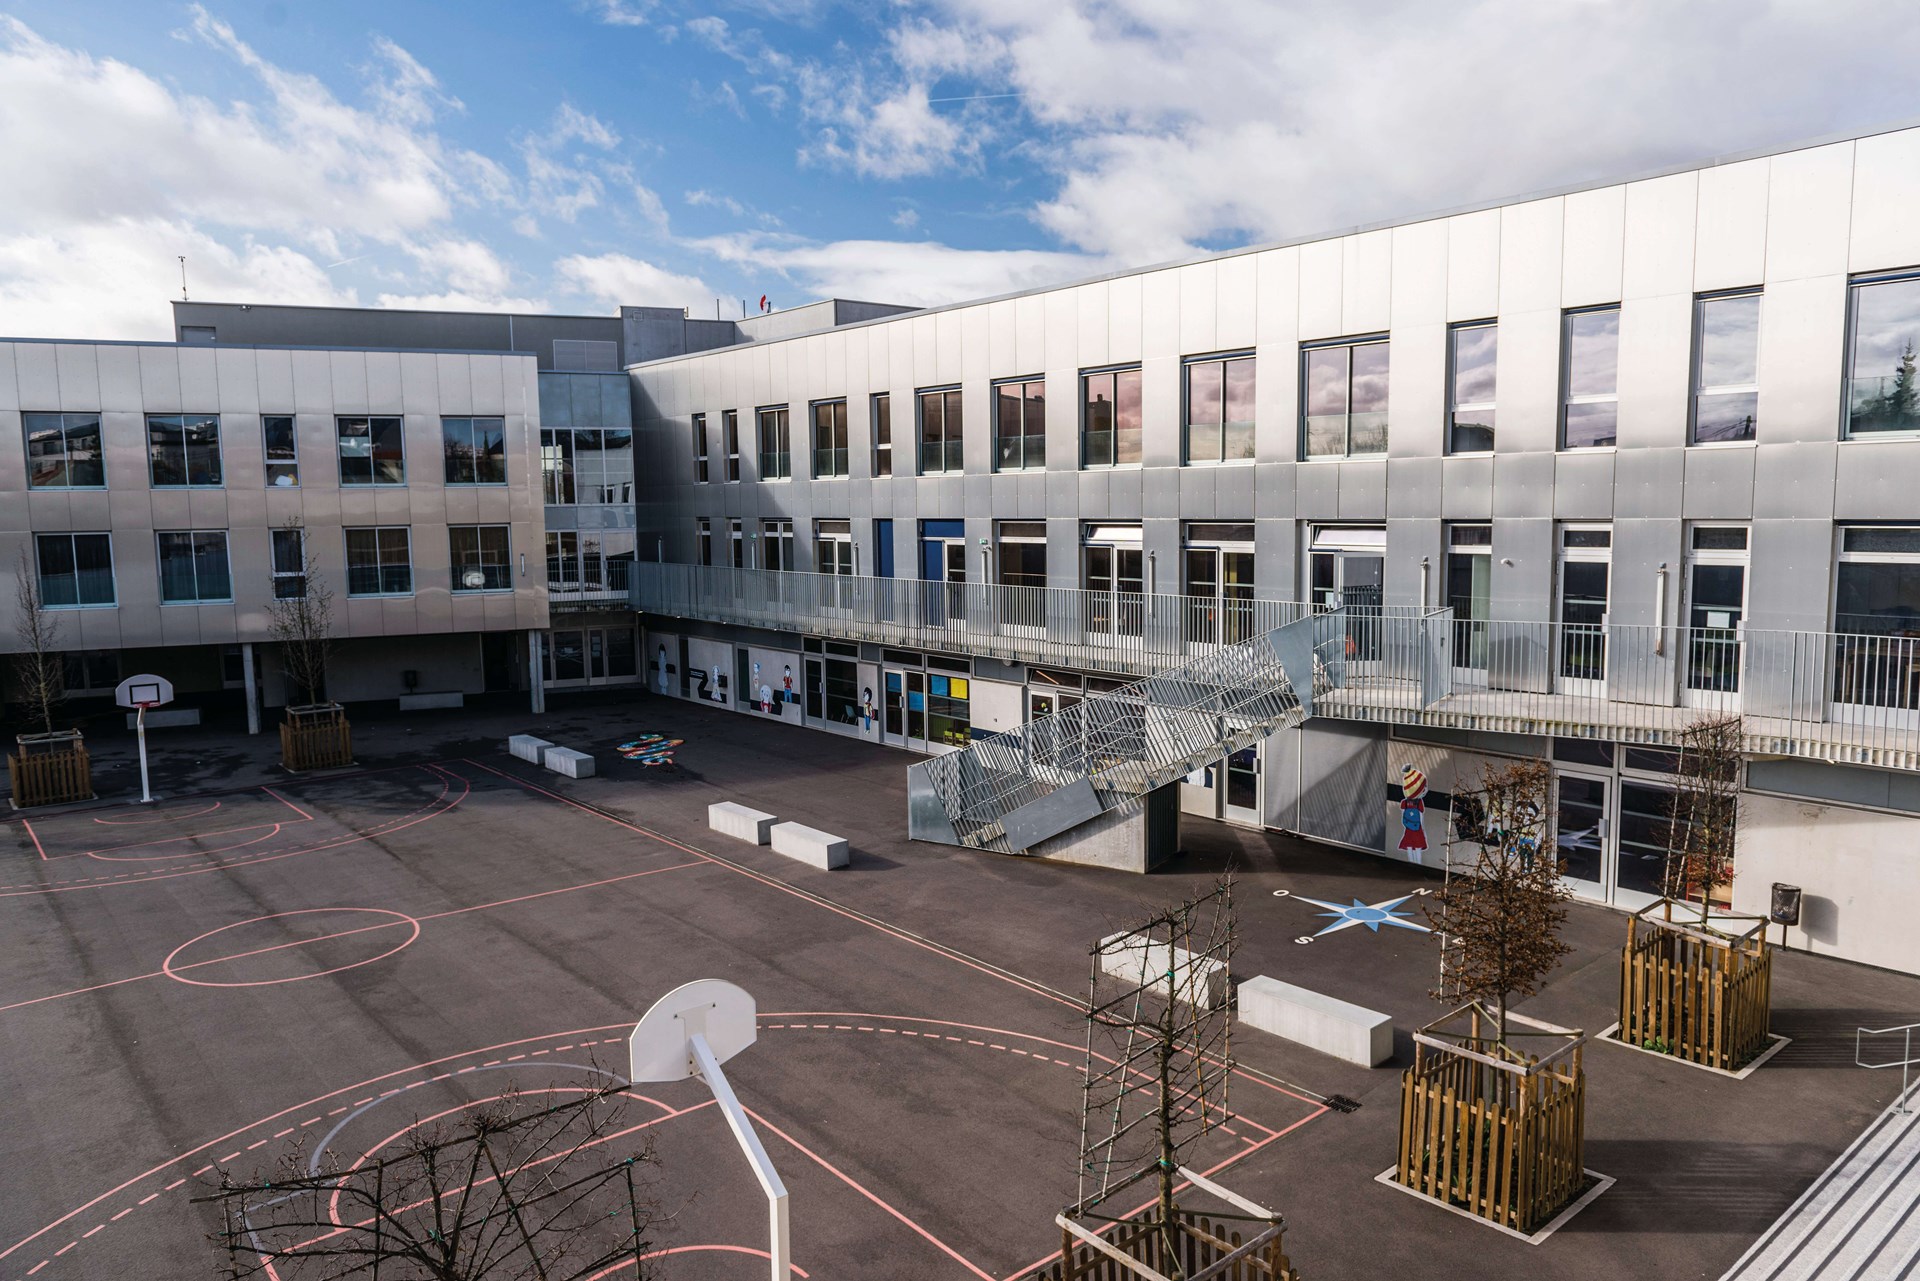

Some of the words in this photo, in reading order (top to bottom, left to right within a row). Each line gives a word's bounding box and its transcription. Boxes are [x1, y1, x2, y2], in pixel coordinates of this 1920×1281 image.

[1272, 889, 1290, 897] O
[1411, 887, 1433, 896] N
[1294, 936, 1314, 945] S
